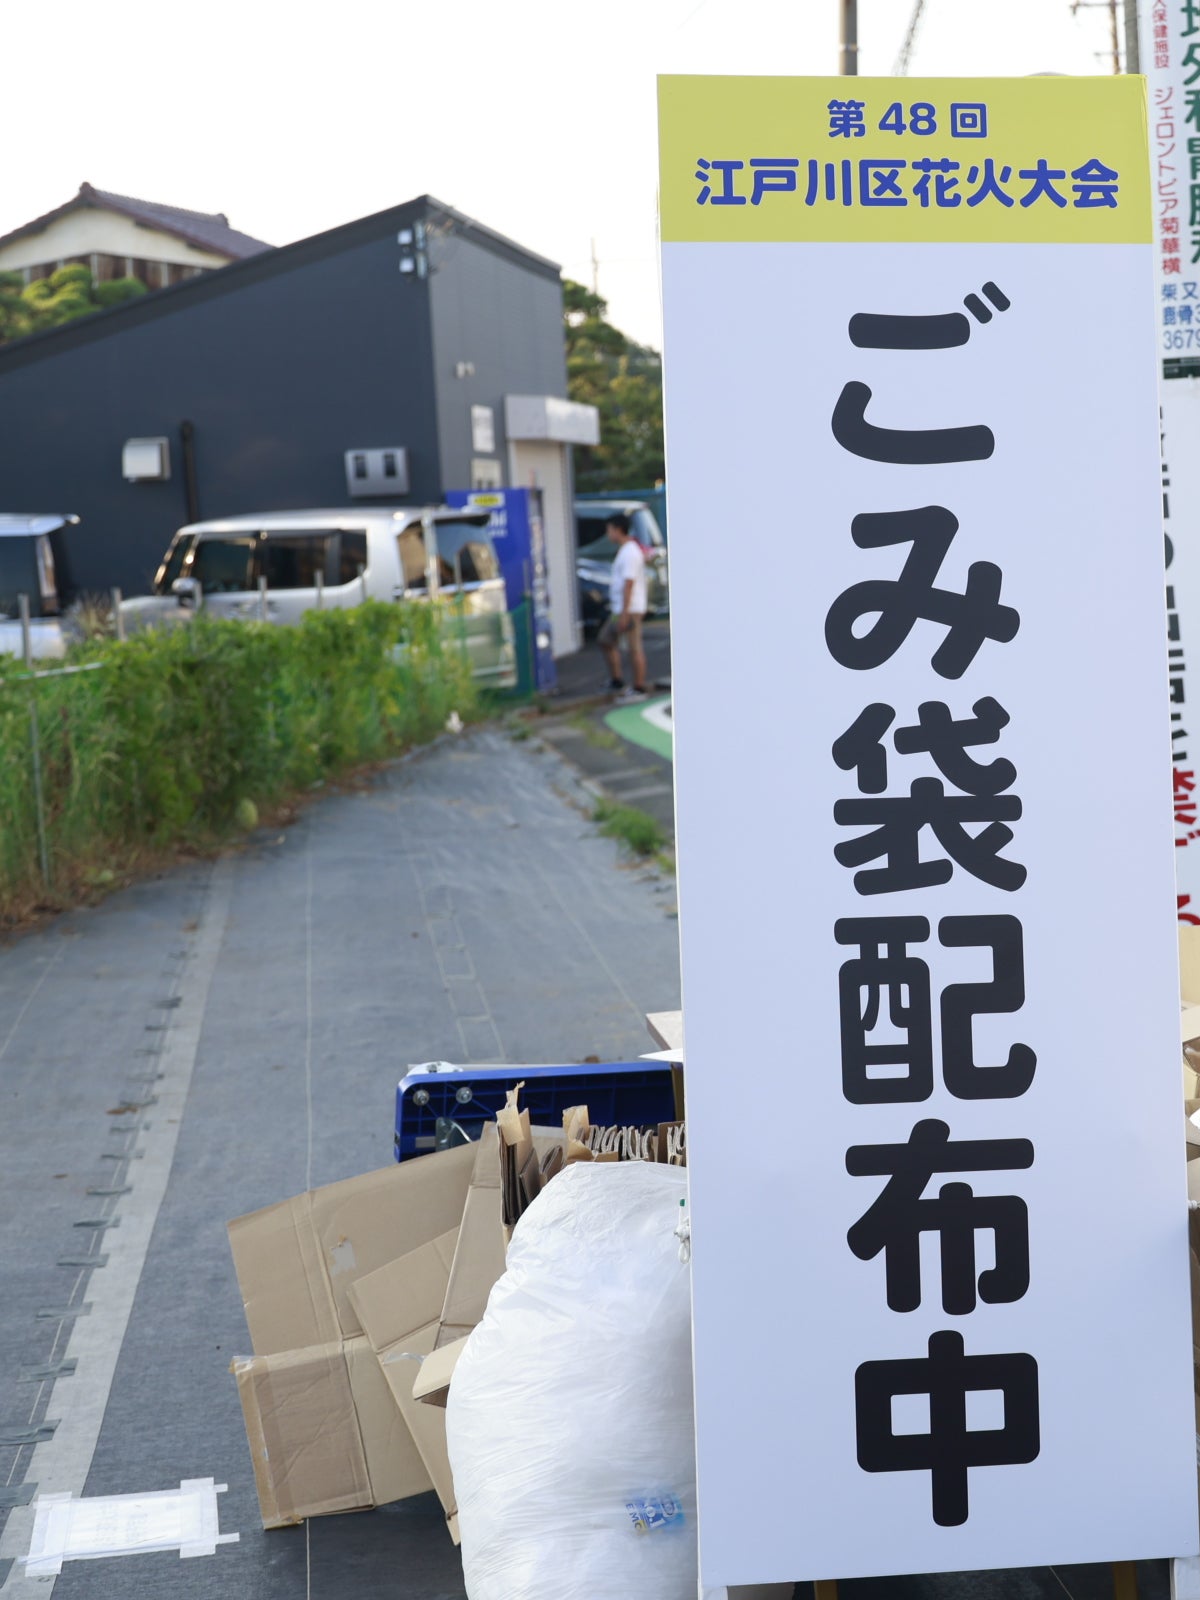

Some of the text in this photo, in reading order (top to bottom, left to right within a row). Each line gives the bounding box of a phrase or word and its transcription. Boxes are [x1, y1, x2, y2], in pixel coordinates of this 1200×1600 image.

[828, 99, 988, 139] 第48回
[695, 157, 1119, 208] 江戸川区花火大会
[824, 281, 1041, 1528] ごみ袋配布中
